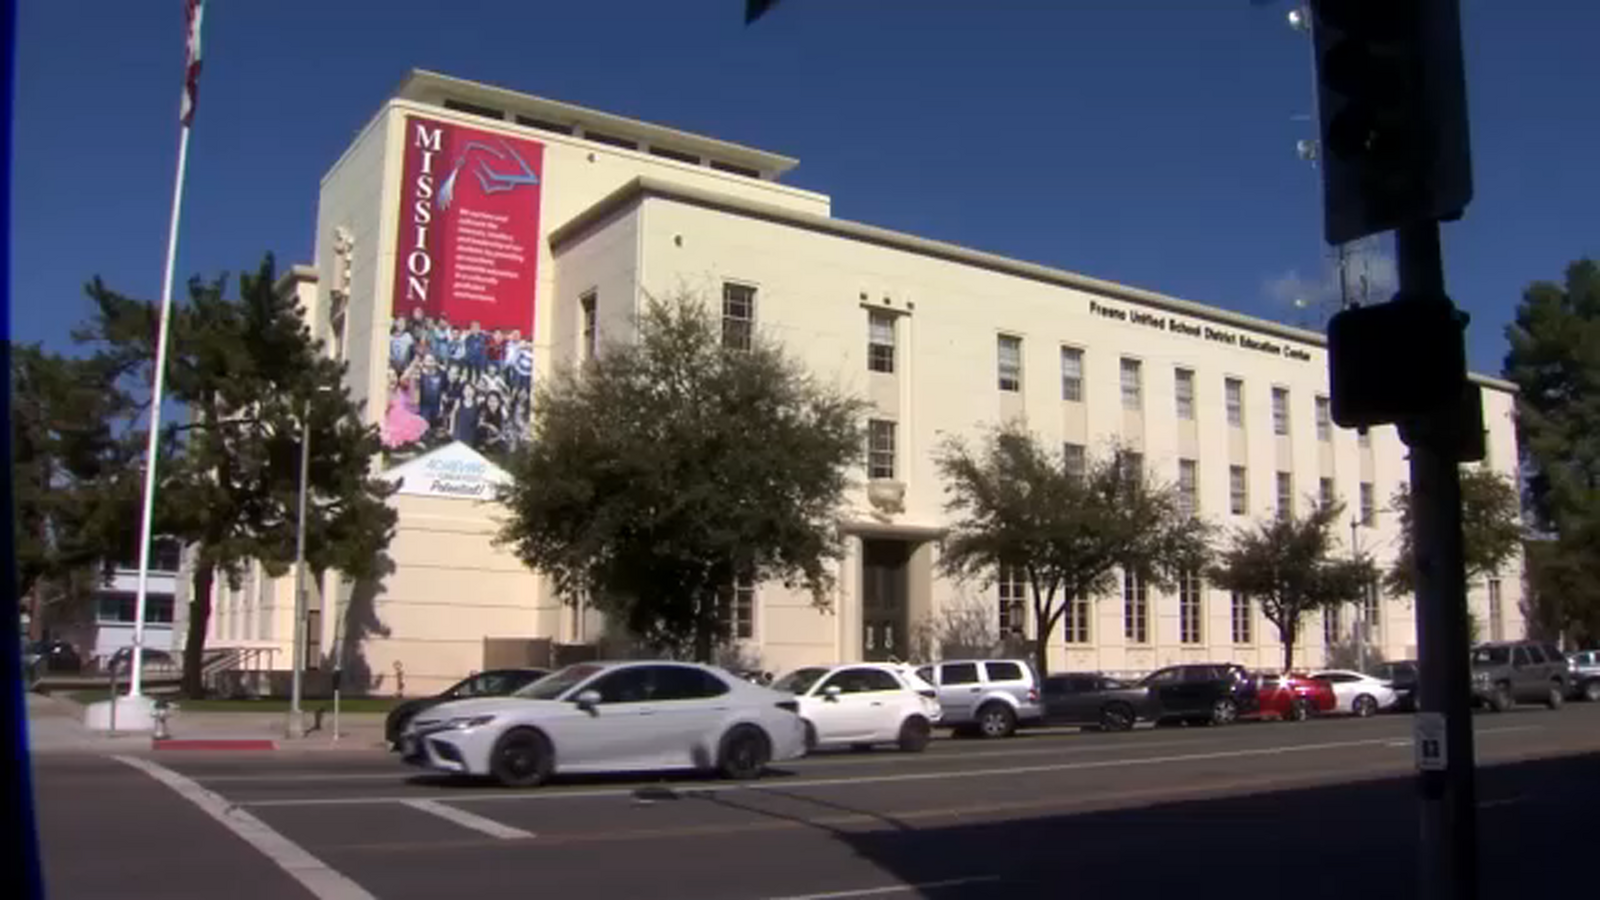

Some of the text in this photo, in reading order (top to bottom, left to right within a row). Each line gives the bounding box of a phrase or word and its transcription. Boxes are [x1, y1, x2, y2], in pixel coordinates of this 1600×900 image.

[406, 123, 443, 301] MISSION
[1089, 300, 1311, 362] Fresno Unified School District Education Center
